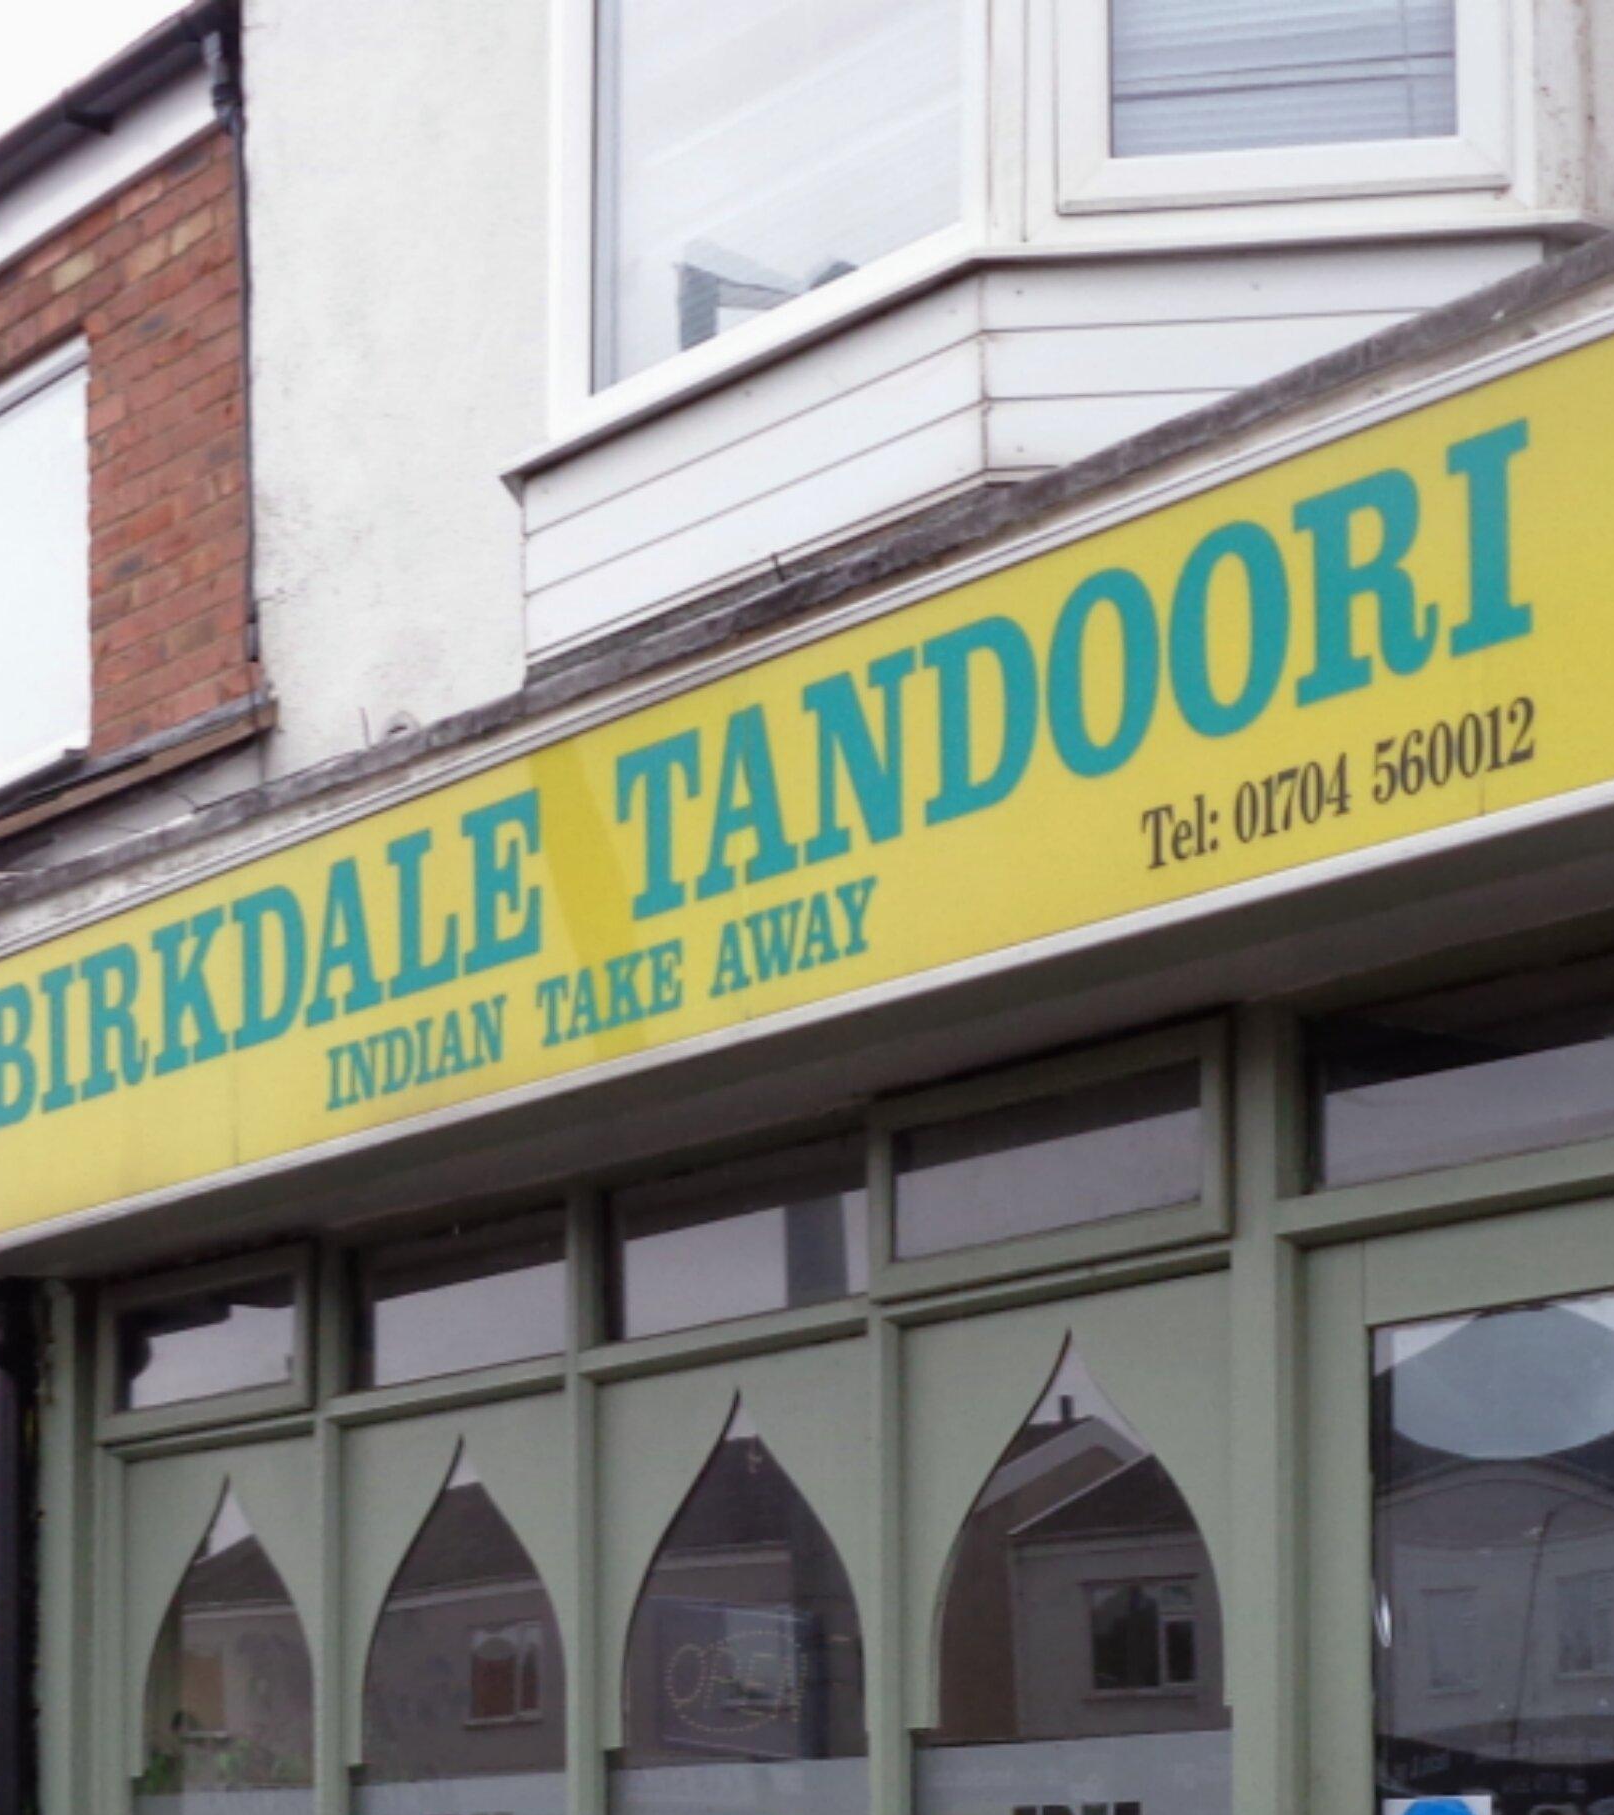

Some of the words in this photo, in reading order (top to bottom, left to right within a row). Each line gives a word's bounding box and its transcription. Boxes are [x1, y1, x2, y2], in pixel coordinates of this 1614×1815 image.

[614, 417, 1533, 921] TANDOORI
[1142, 794, 1220, 870] Tel:
[1234, 752, 1351, 844] 01704
[1371, 696, 1535, 804] 560012
[325, 996, 508, 1113] INDIAN
[535, 938, 684, 1048] TAKE
[709, 876, 878, 997] AWAY
